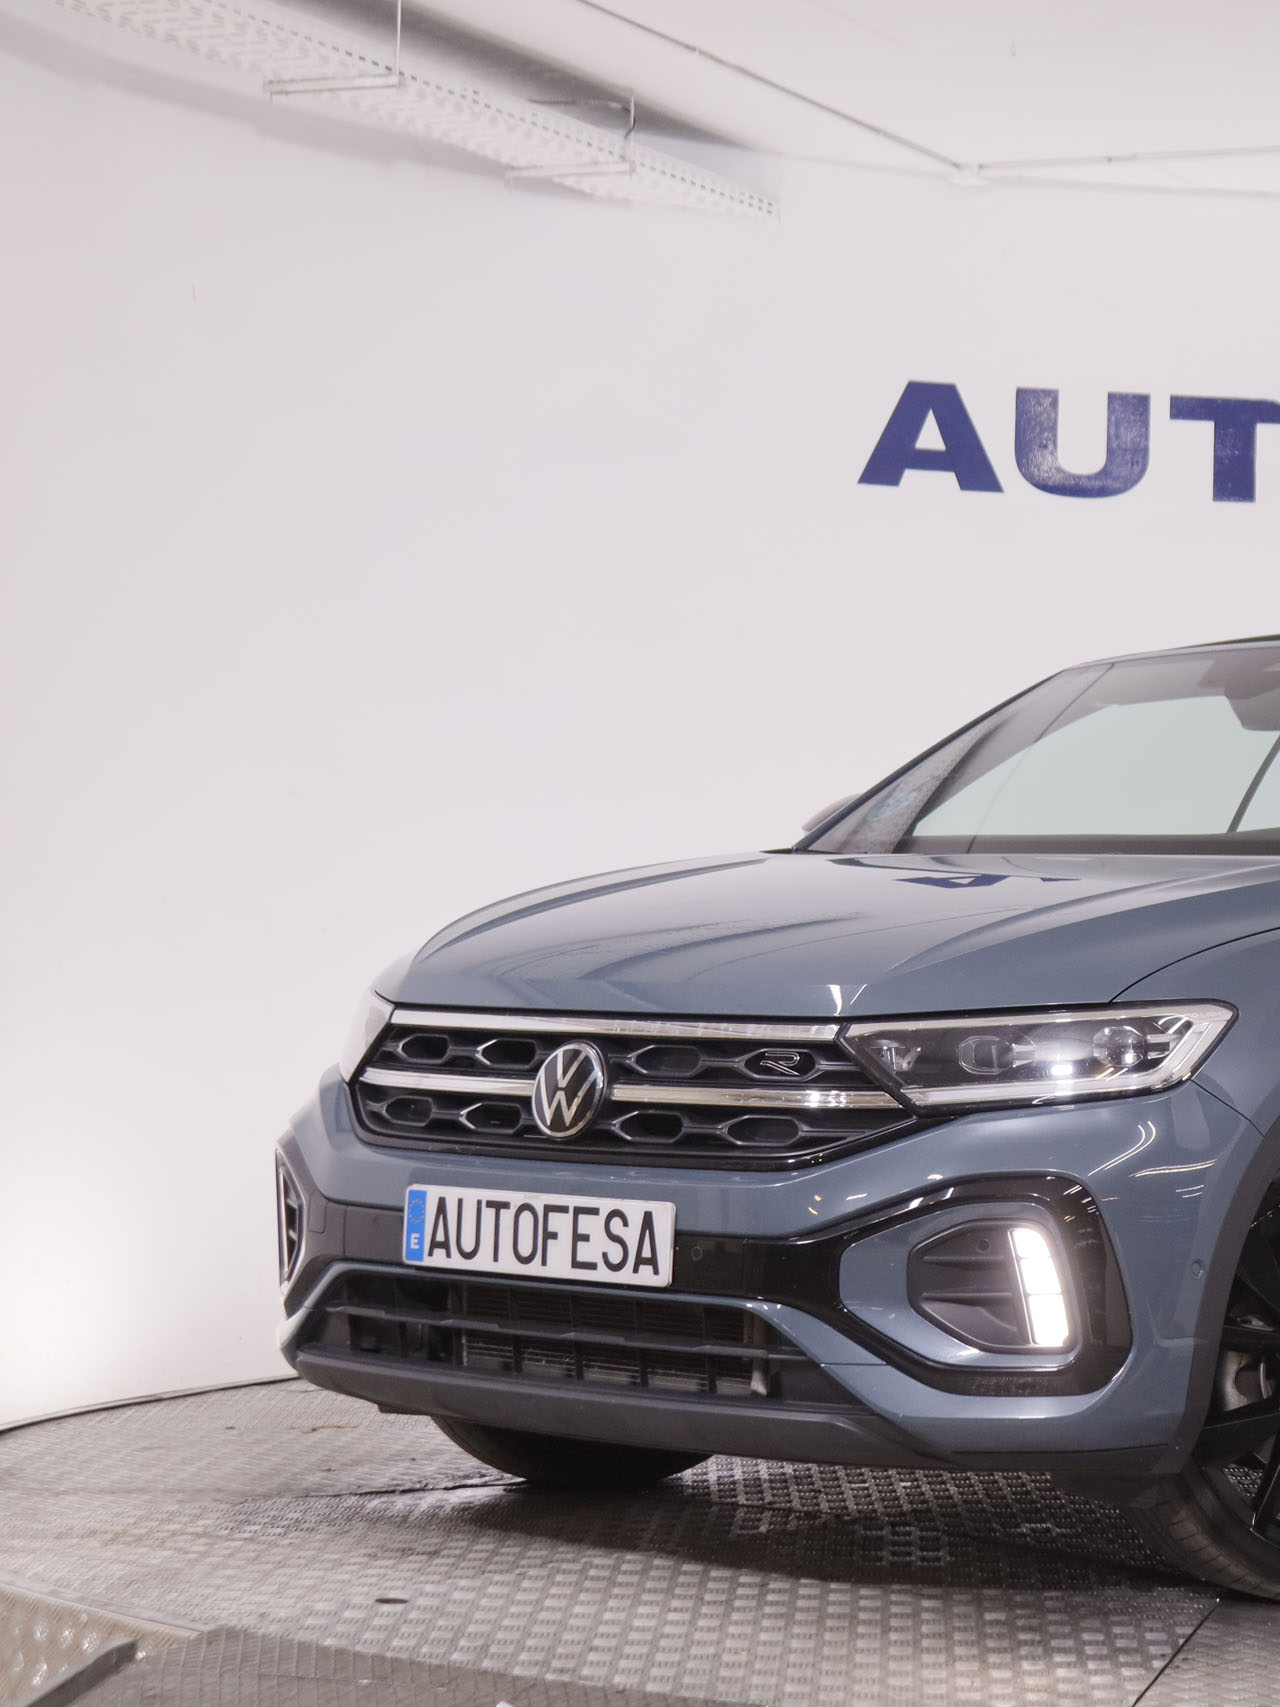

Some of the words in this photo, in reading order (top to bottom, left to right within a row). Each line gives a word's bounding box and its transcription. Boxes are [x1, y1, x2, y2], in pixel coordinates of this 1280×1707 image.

[759, 1050, 801, 1076] R
[410, 1233, 420, 1250] E
[427, 1196, 660, 1277] AUTOFESA
